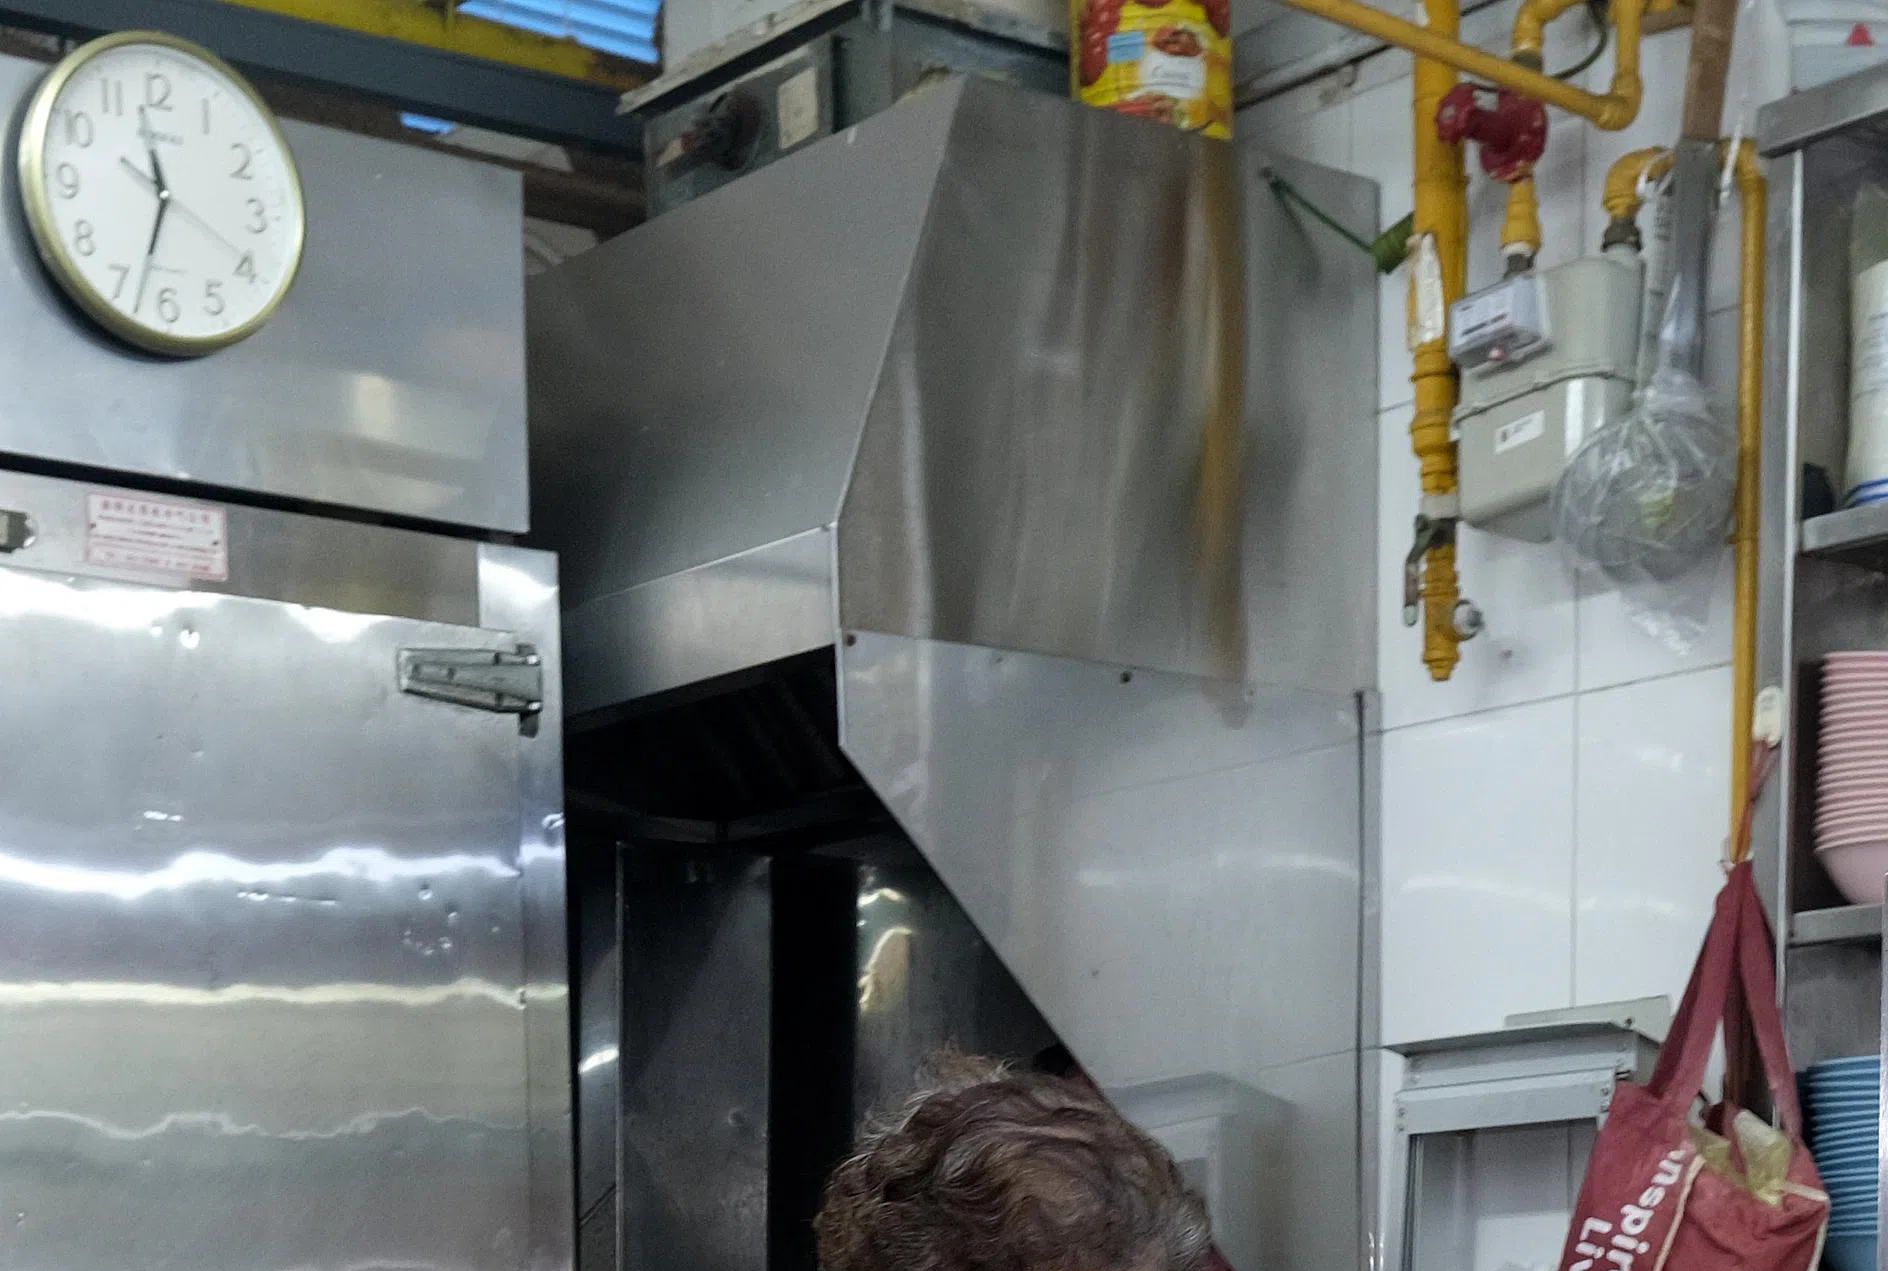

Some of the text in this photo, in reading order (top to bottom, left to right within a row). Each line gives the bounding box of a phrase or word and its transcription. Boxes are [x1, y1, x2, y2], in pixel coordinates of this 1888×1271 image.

[100, 77, 124, 117] 11
[64, 109, 95, 149] 10
[230, 143, 254, 180] 2
[56, 163, 80, 199] 9
[246, 198, 269, 234] 3
[74, 219, 96, 257] 8
[108, 265, 131, 300] 7
[234, 250, 259, 284] 4
[158, 287, 180, 323] 6
[204, 281, 226, 316] 5
